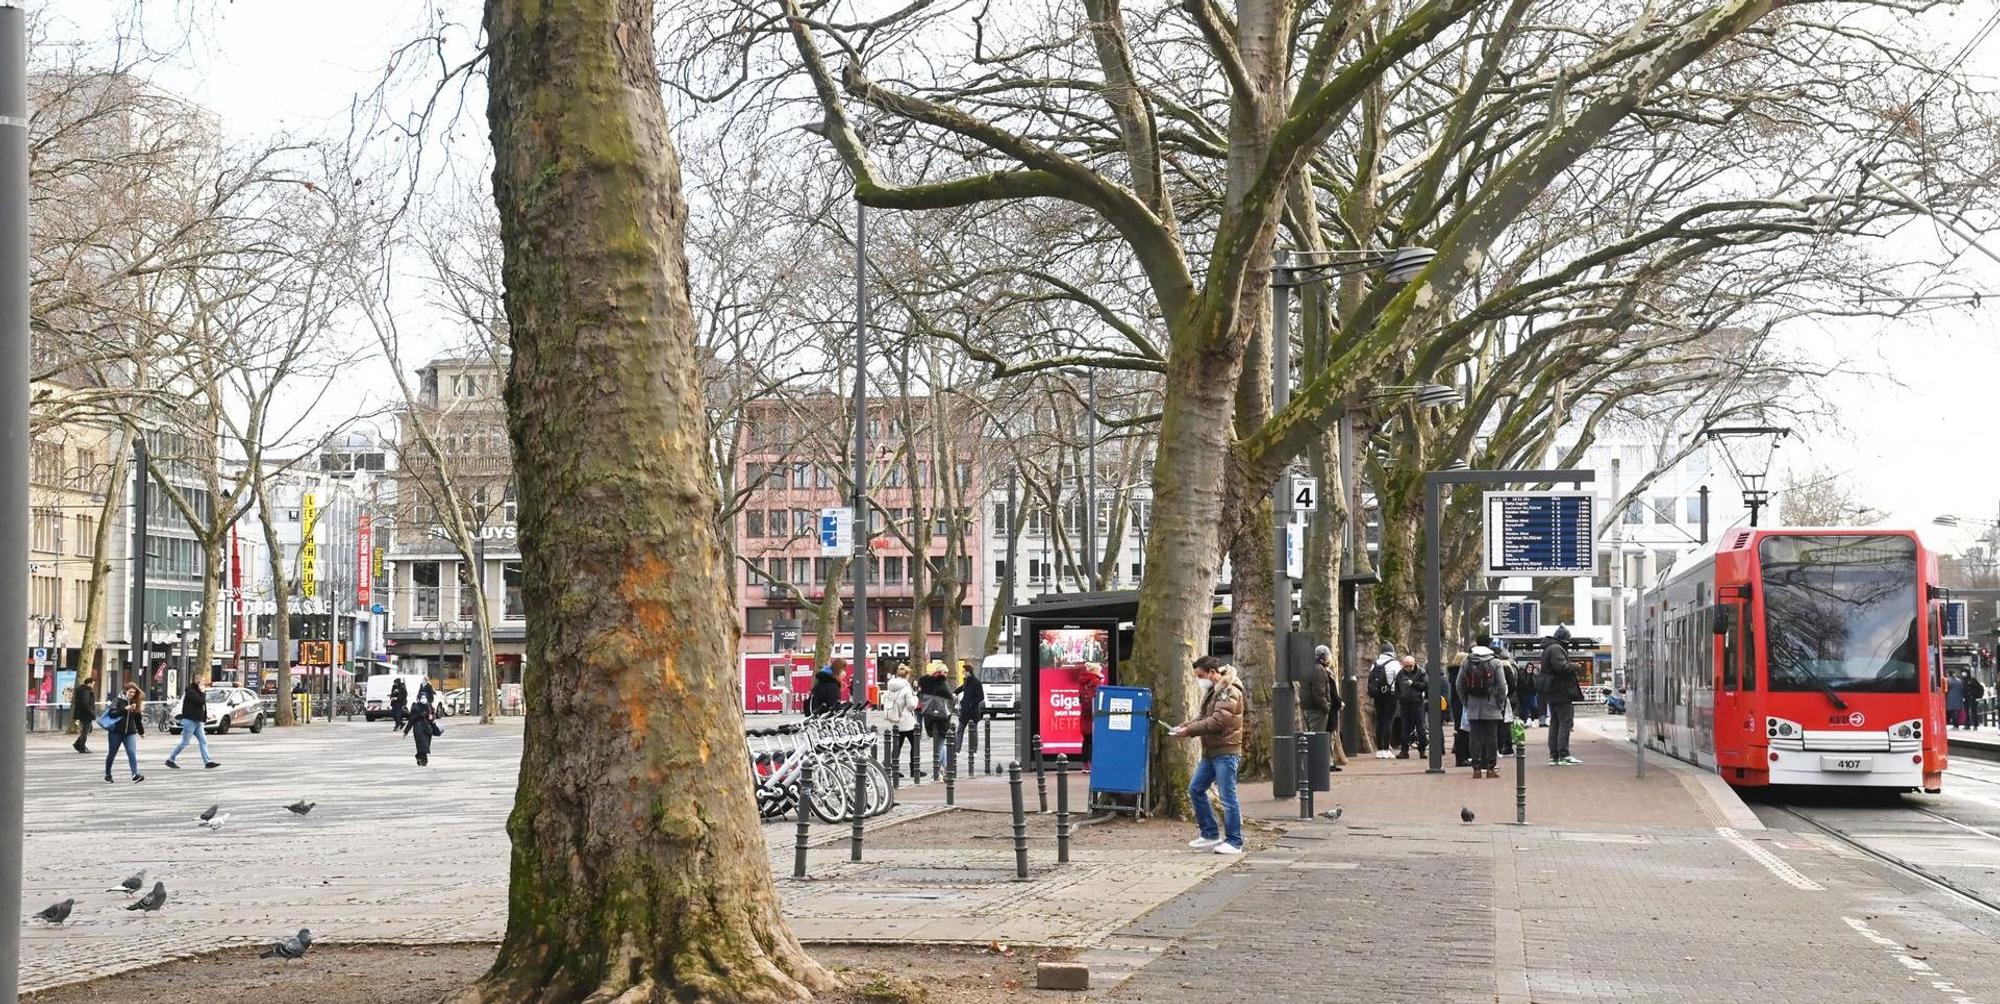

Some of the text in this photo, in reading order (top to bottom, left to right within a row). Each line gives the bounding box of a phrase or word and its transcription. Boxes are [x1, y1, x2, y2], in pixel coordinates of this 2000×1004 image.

[1296, 487, 1313, 508] 4
[1050, 693, 1080, 710] Giga
[1838, 760, 1861, 769] 4107
